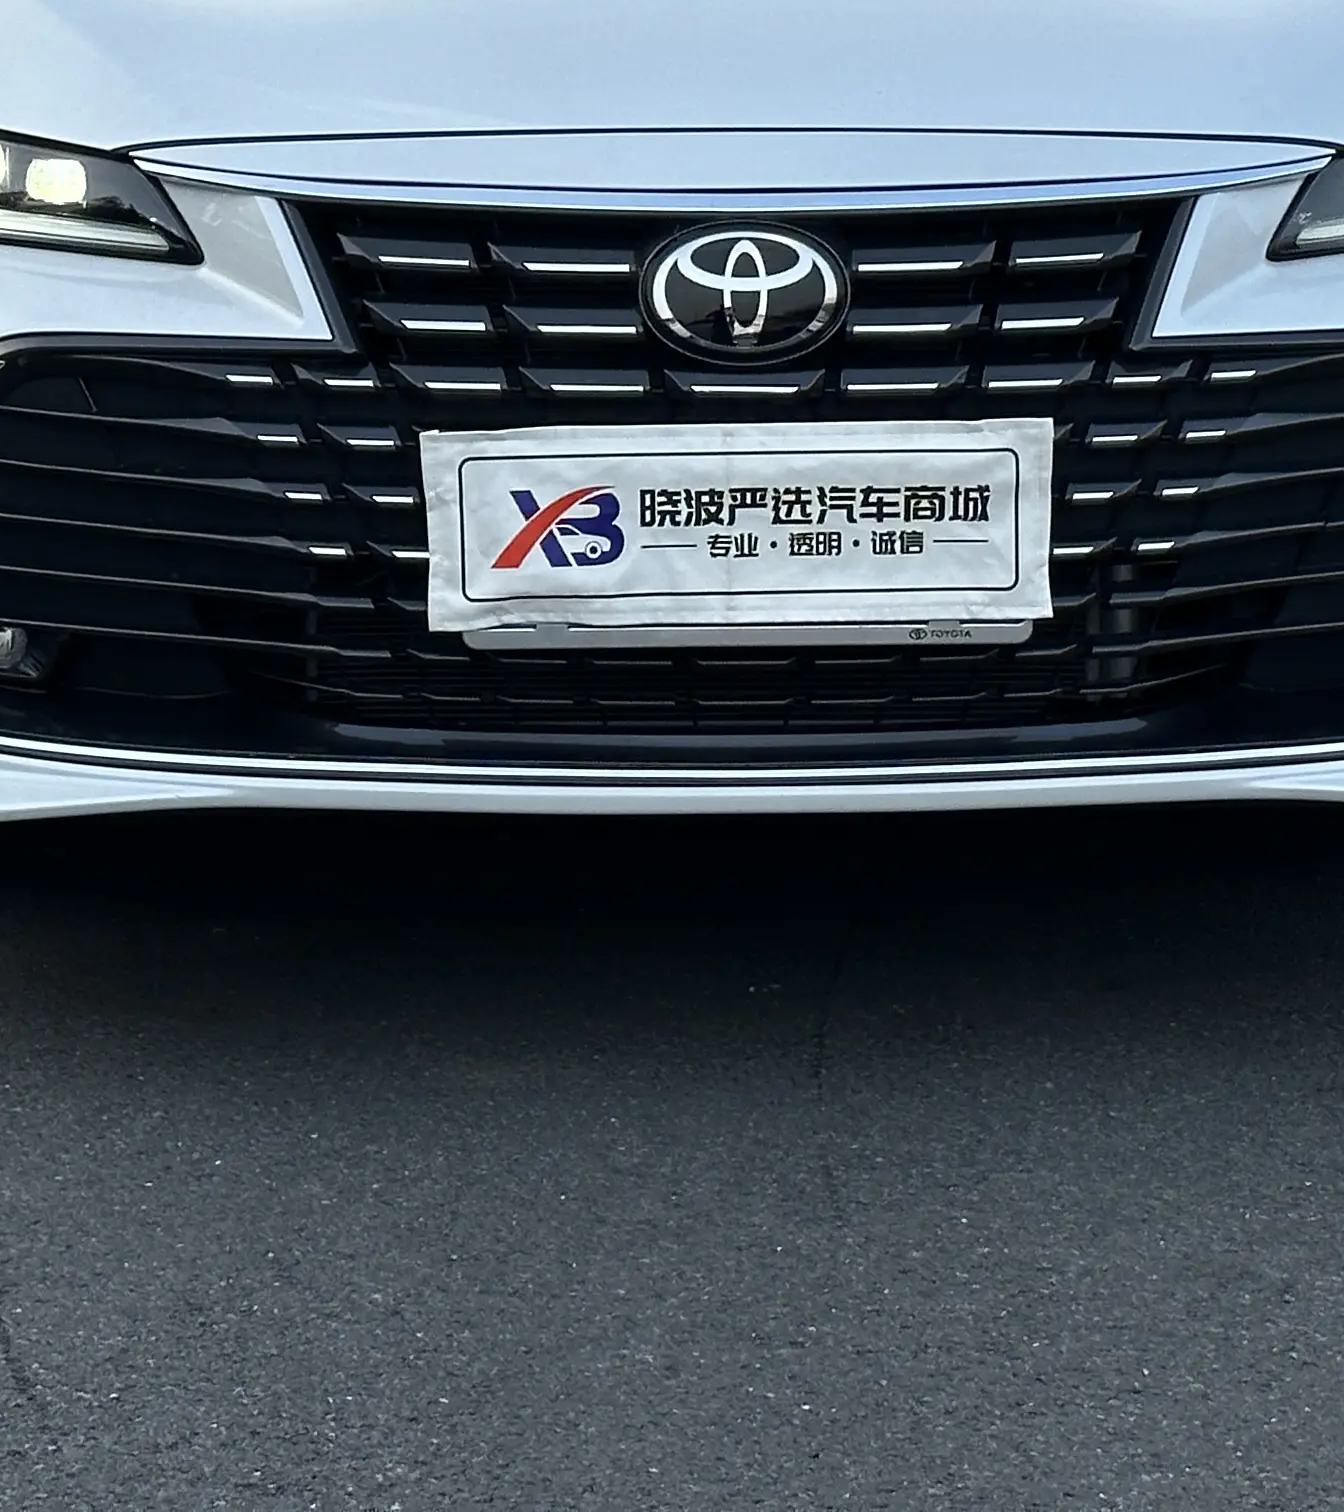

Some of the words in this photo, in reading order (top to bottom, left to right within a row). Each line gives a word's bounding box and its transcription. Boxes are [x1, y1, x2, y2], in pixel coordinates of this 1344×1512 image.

[639, 484, 991, 527] 晓波严选汽车商城
